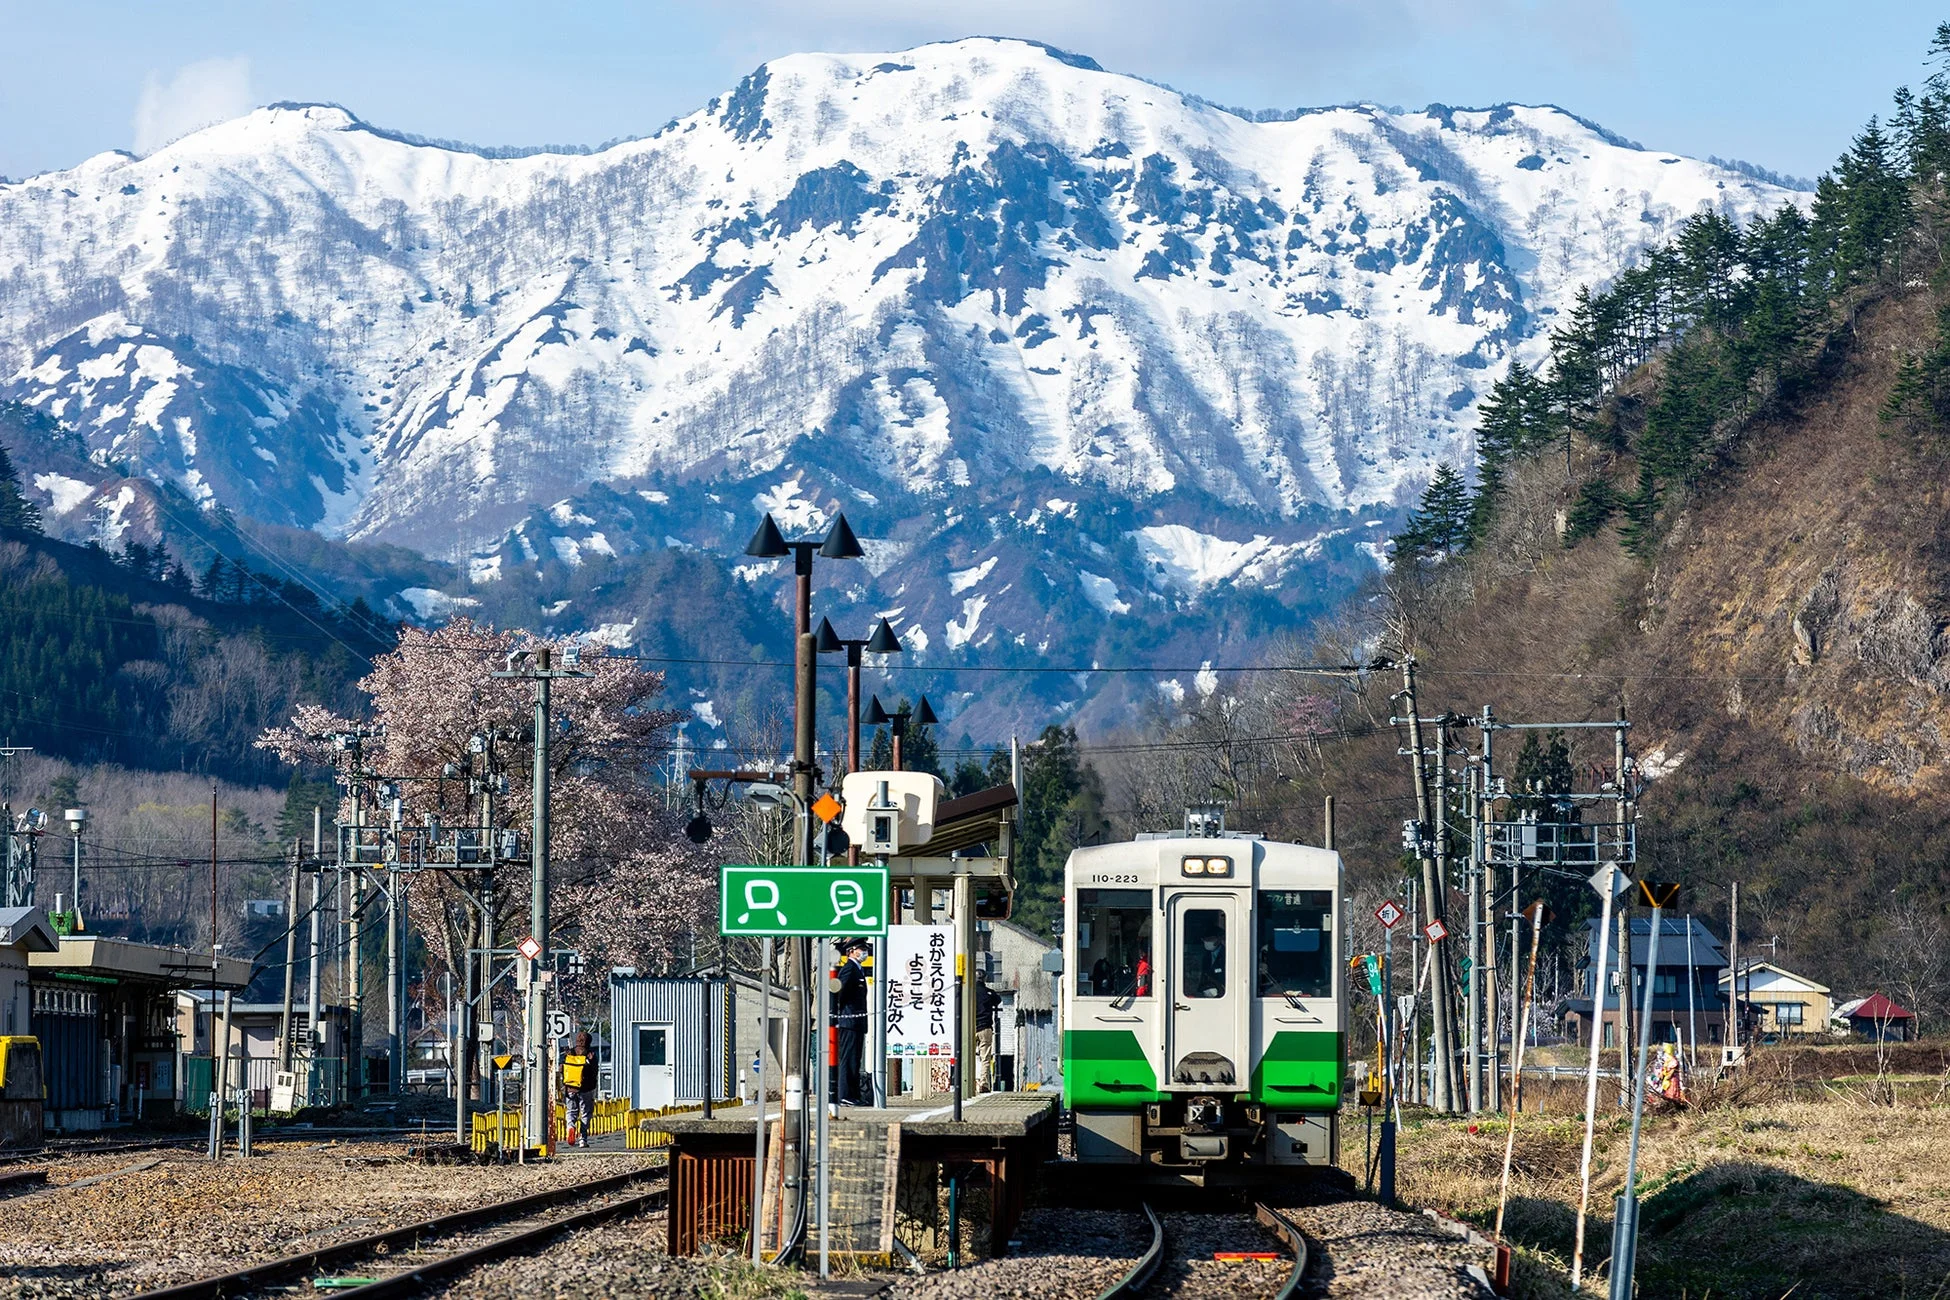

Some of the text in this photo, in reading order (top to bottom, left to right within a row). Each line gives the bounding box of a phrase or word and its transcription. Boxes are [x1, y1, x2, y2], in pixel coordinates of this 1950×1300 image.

[737, 879, 878, 926] 只見
[1092, 874, 1139, 883] 110-223
[886, 978, 905, 1036] ただみへ
[908, 952, 924, 1011] ようこそ
[929, 932, 946, 1036] おかえりなさい
